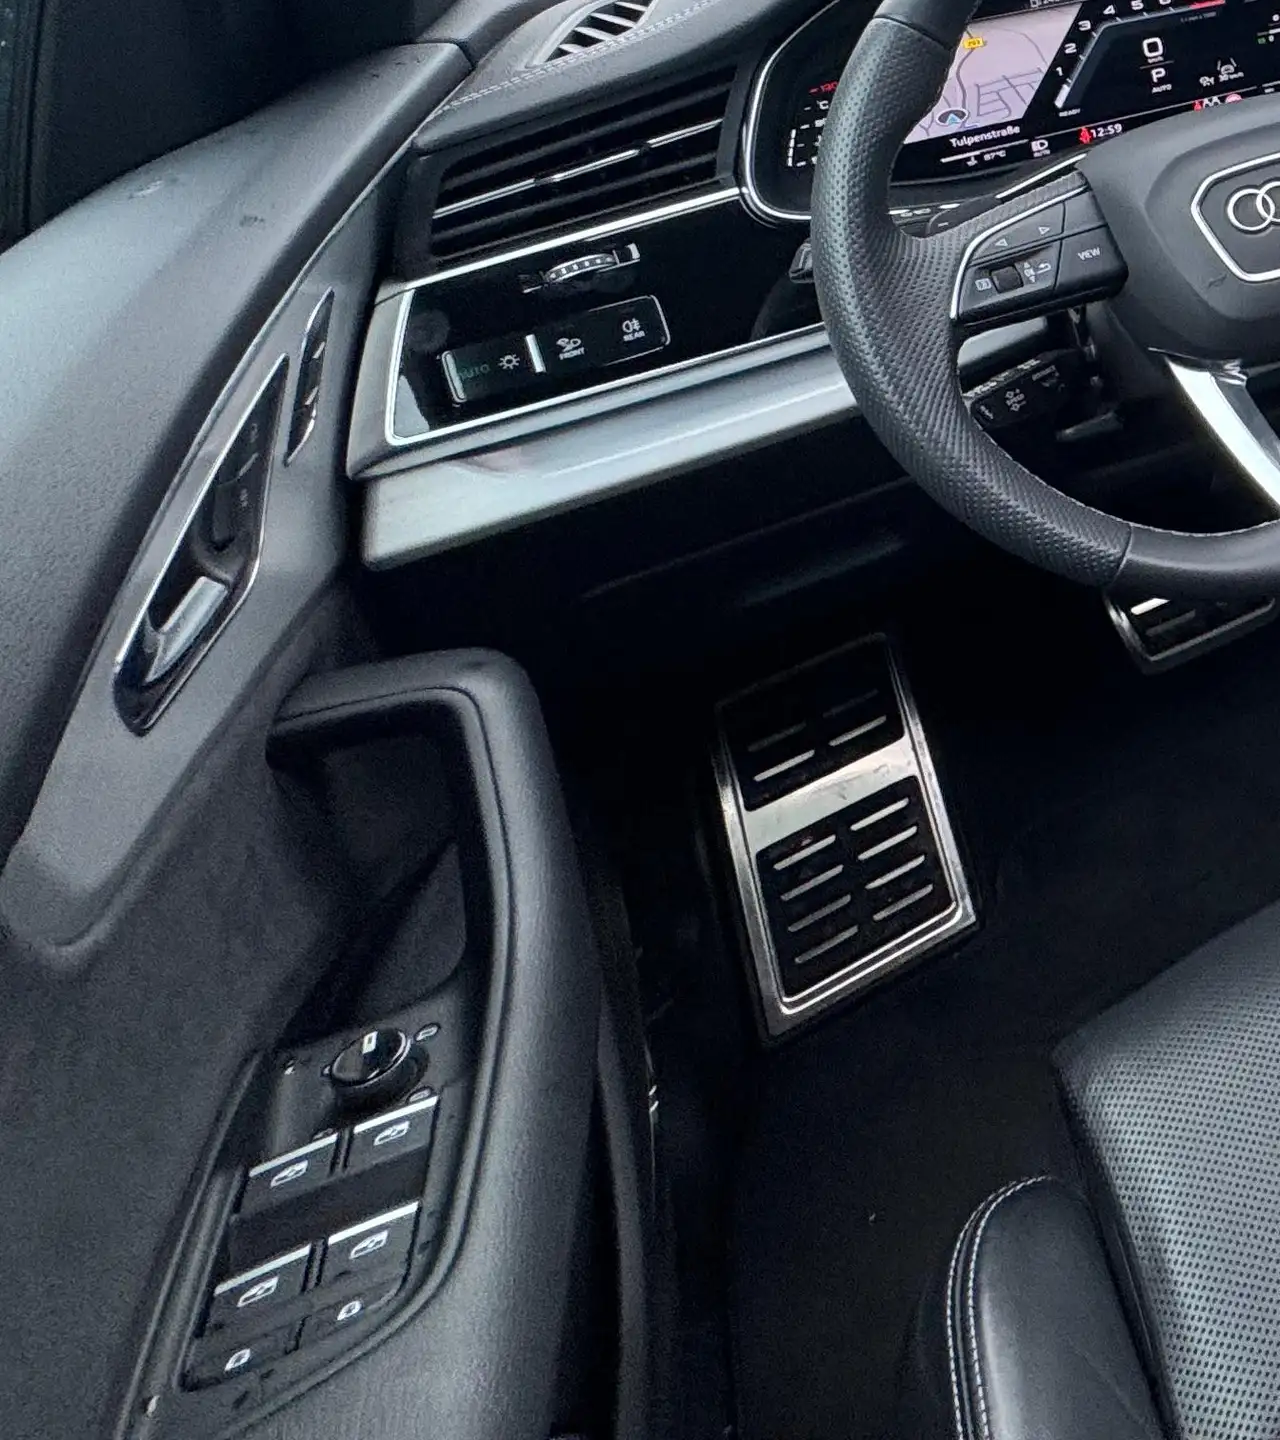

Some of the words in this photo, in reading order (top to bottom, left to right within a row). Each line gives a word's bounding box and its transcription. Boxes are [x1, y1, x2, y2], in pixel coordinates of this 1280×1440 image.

[1103, 4, 1116, 15] 4
[1131, 0, 1144, 10] 5
[1078, 20, 1091, 31] 3
[1064, 43, 1077, 54] 2
[1142, 37, 1164, 58] 0
[1056, 66, 1064, 77] 1
[1151, 67, 1166, 83] P
[1151, 83, 1173, 94] AUTO
[950, 124, 1021, 148] Tulpenstraße
[1090, 122, 1123, 139] 12:59
[1077, 247, 1101, 261] VIEW
[623, 330, 646, 342] REAR
[559, 347, 585, 360] FRONT
